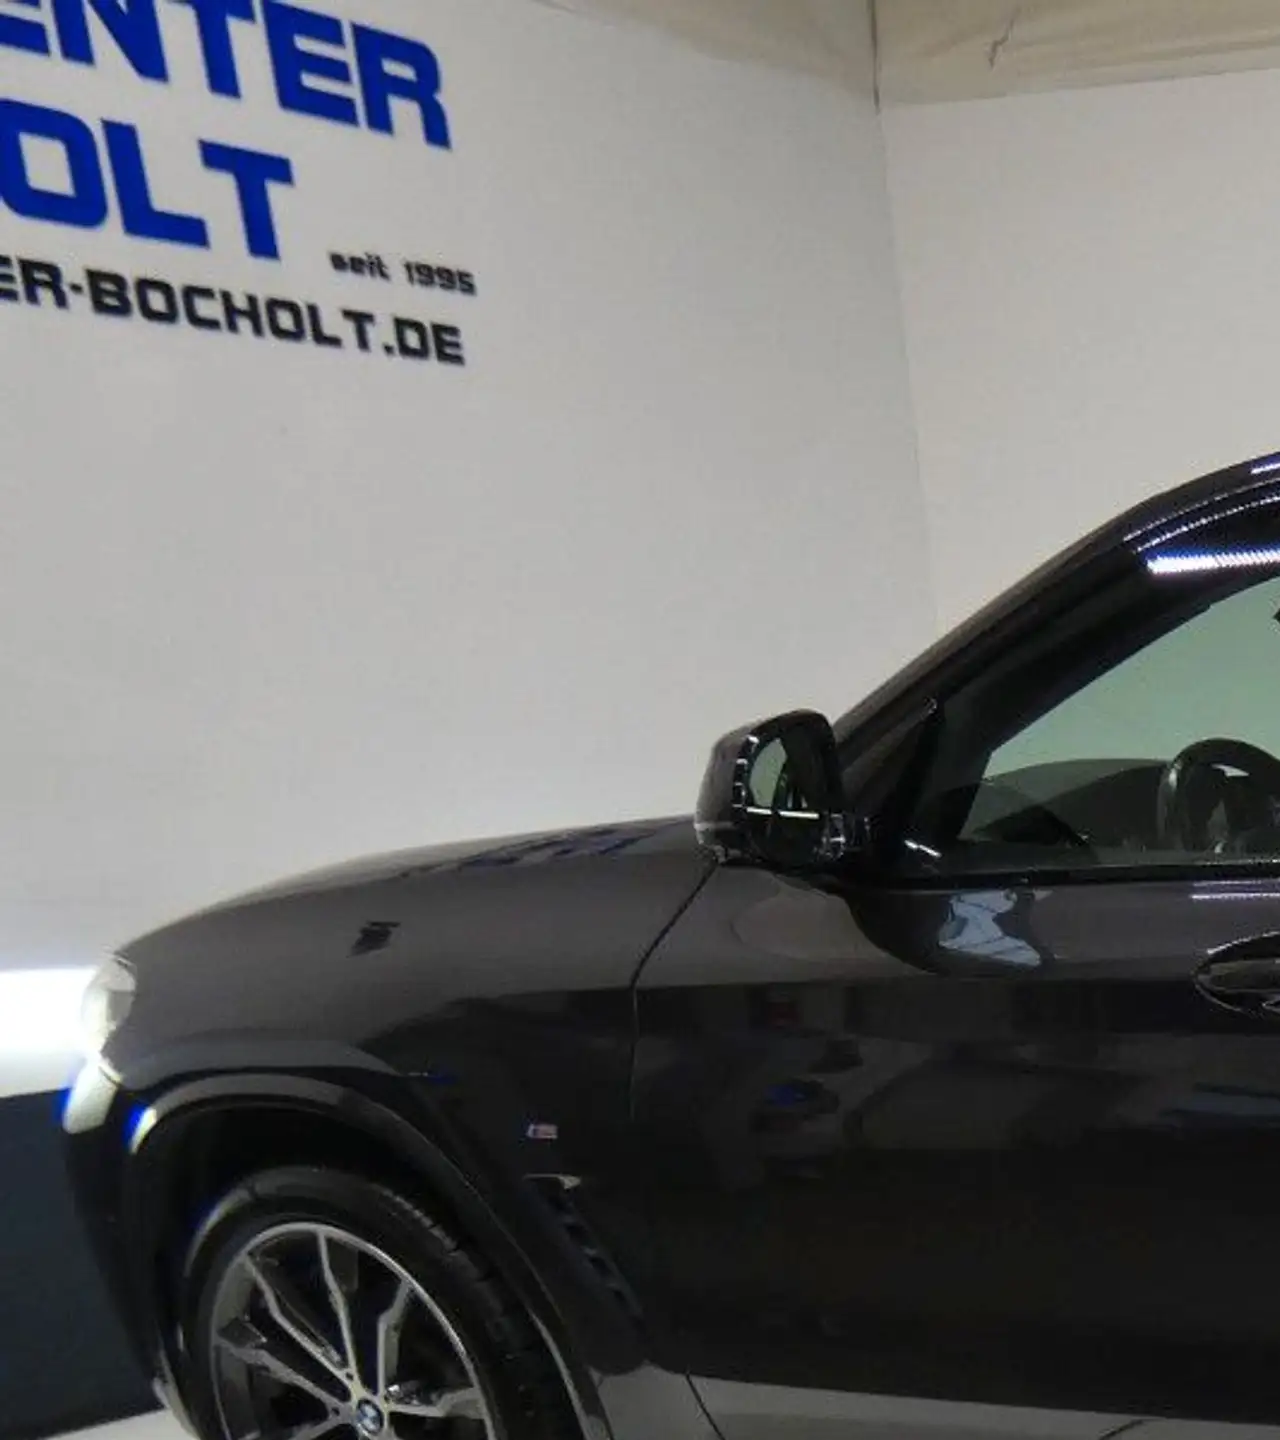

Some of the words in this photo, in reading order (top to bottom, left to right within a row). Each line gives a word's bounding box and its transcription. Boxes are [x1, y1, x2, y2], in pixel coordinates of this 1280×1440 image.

[0, 98, 294, 260] OLT
[329, 251, 391, 282] seit
[403, 260, 477, 296] 1995
